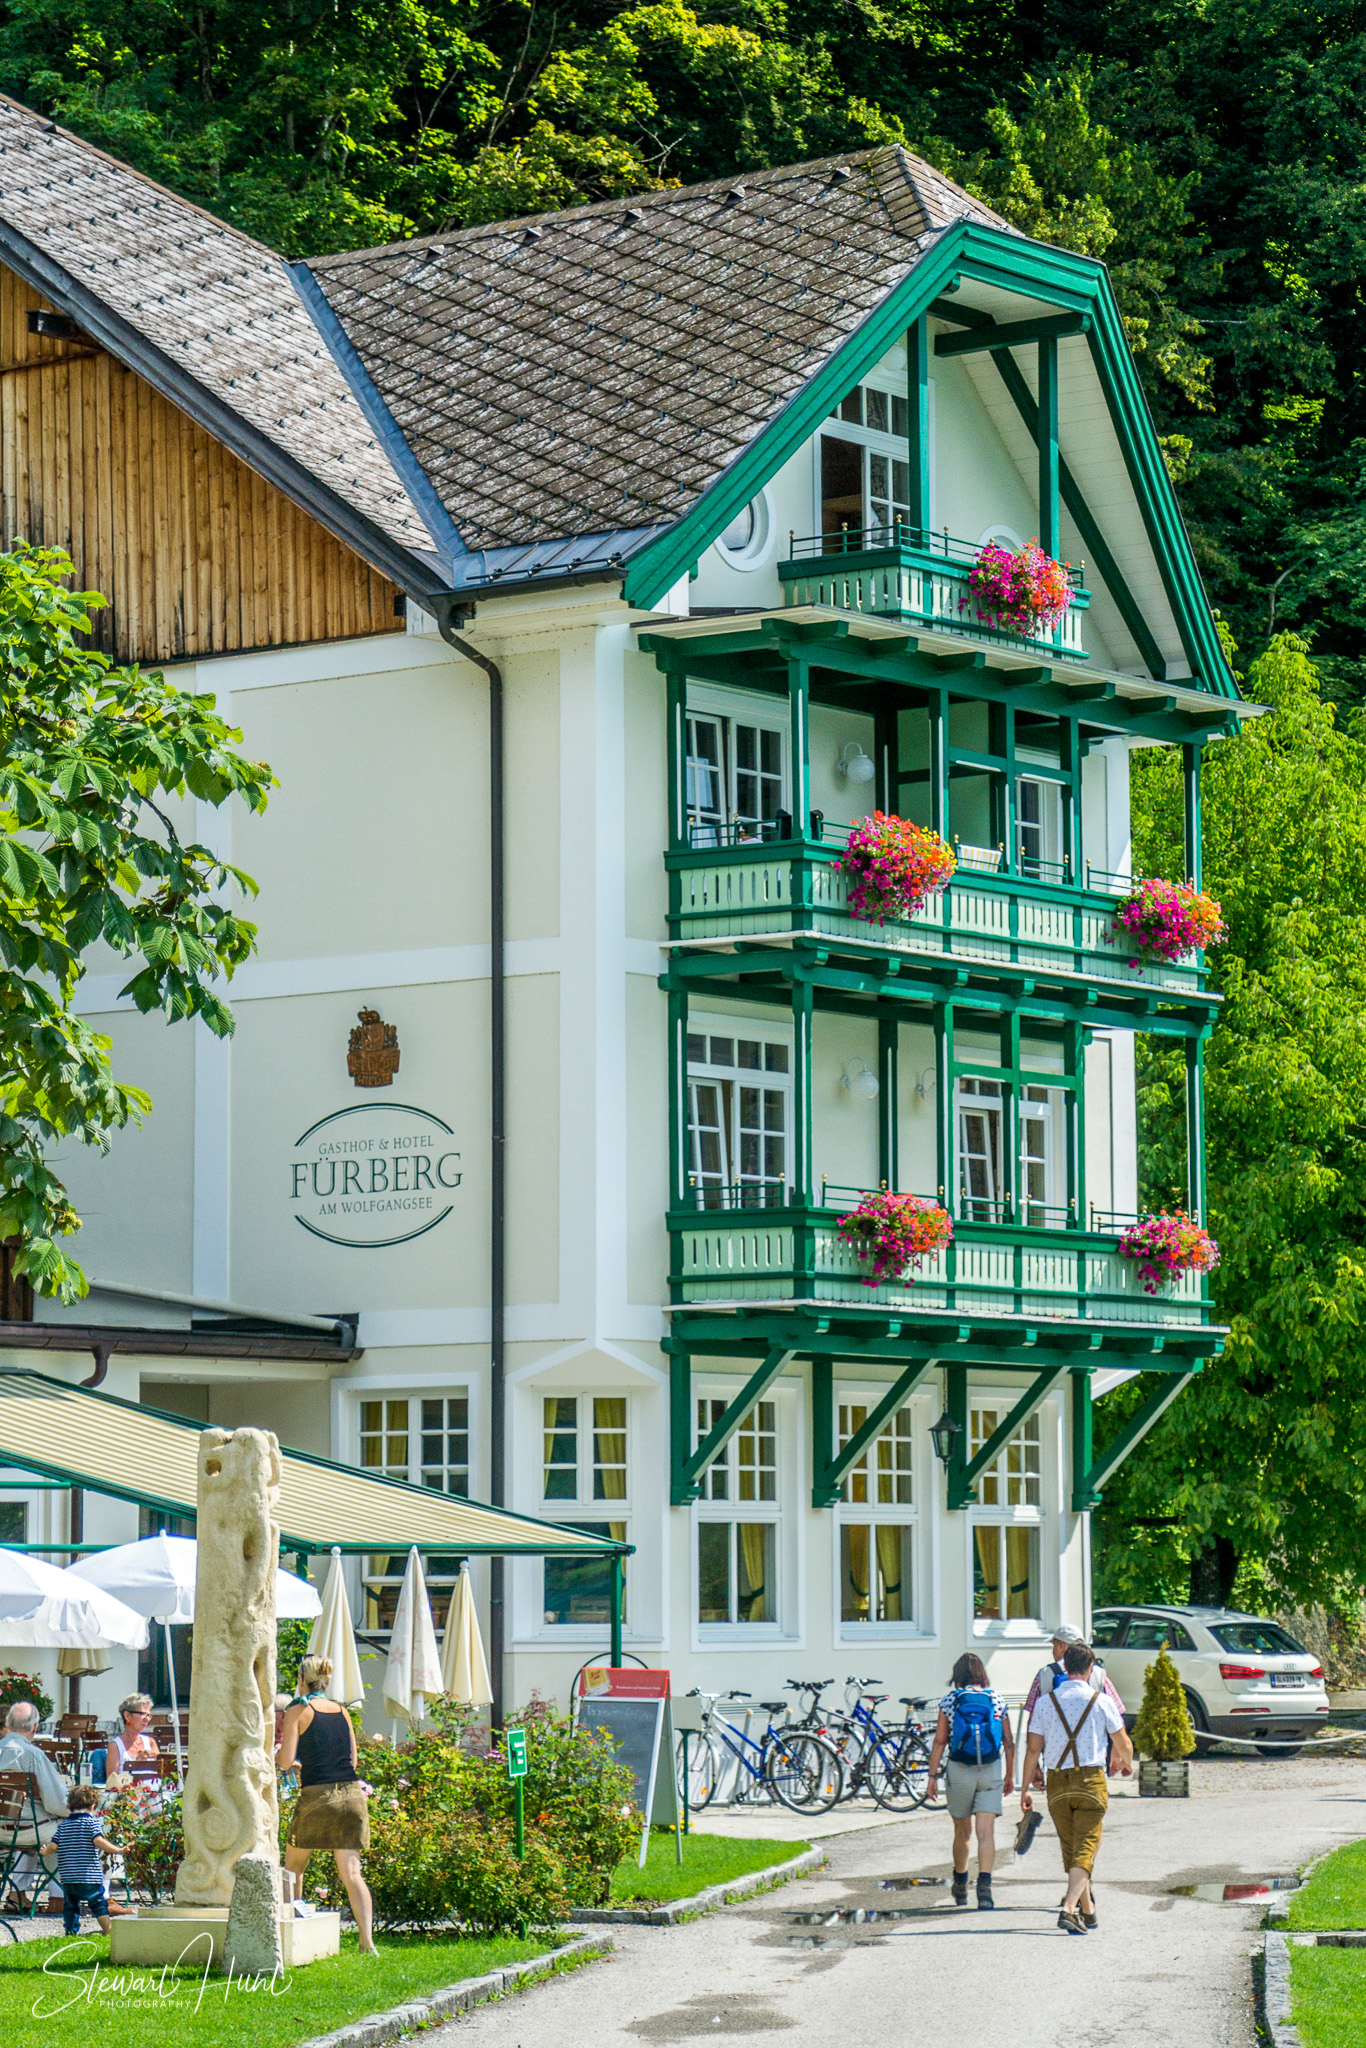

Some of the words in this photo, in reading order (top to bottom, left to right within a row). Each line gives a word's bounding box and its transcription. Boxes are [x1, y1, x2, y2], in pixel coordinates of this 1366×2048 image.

[318, 1139, 375, 1155] GASTHOF
[378, 1138, 390, 1151] &
[393, 1135, 435, 1150] HOTEL
[289, 1152, 464, 1199] FÜRBERG
[318, 1202, 337, 1216] AM
[341, 1196, 433, 1214] WOLFGANGSEE
